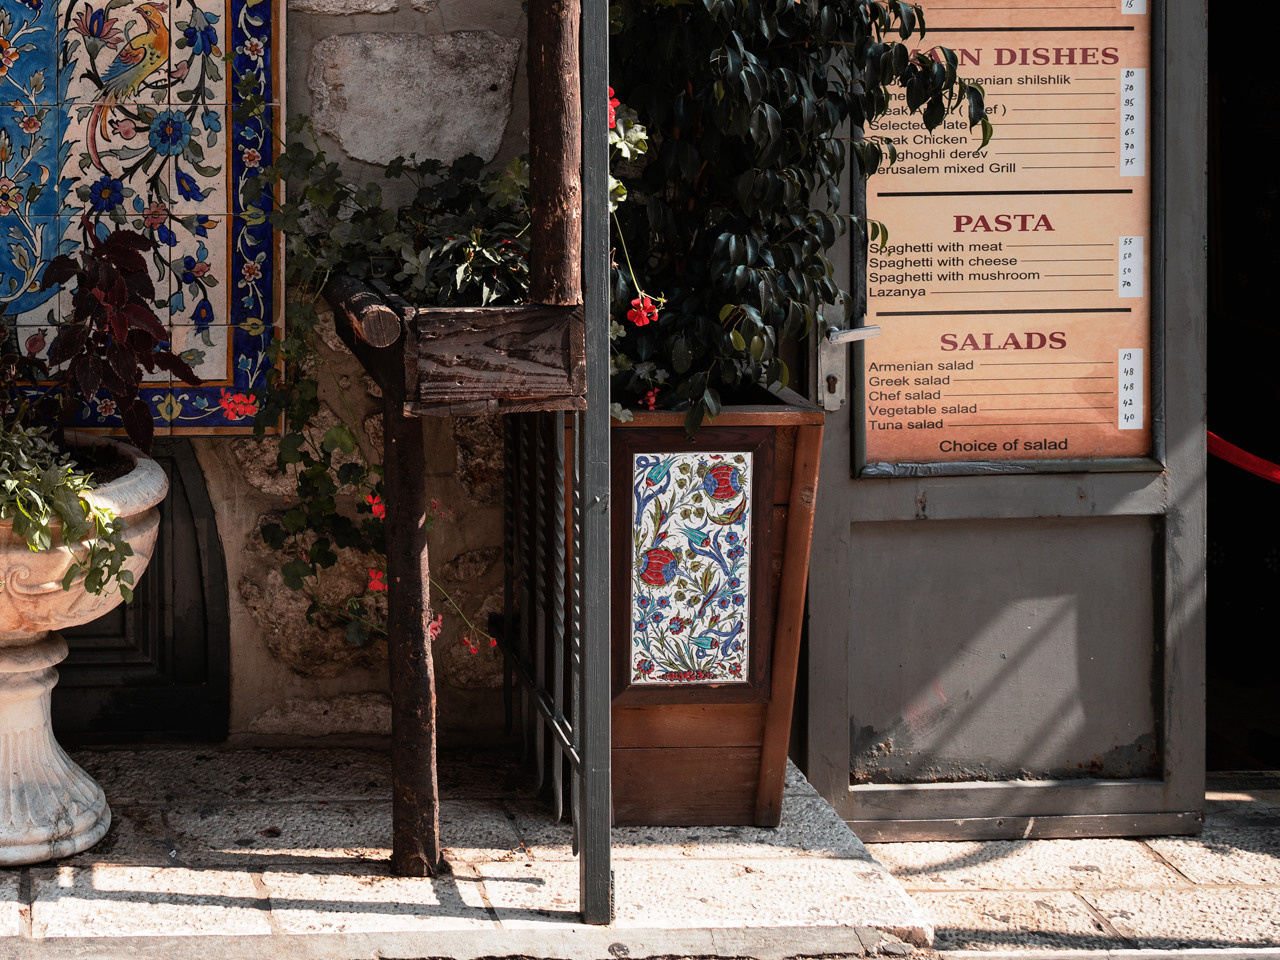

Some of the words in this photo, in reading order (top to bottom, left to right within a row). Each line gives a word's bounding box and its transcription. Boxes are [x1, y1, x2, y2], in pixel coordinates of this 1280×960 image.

[993, 46, 1120, 66] DISHES
[952, 75, 1013, 86] menian
[1017, 74, 1071, 85] shilshlik
[1125, 70, 1135, 79] 80
[1124, 84, 1134, 92] 70
[1123, 97, 1135, 107] 95
[878, 105, 909, 116] eak
[1124, 113, 1135, 122] 70
[937, 118, 968, 130] late
[1124, 128, 1135, 136] 65
[870, 135, 909, 145] Stak
[913, 134, 968, 145] Chicken
[1124, 142, 1135, 151] 70
[949, 148, 989, 159] derev
[1124, 157, 1136, 166] 75
[876, 164, 940, 175] erusalem
[944, 163, 985, 174] mixed
[988, 162, 1016, 174] Grill
[952, 213, 1056, 233] PASTA
[1123, 237, 1133, 246] 55
[869, 242, 933, 256] Spaghetti
[937, 241, 964, 253] with
[968, 241, 1003, 252] meat
[869, 256, 933, 270] Spaghetti
[936, 256, 964, 267] with
[968, 256, 1018, 267] cheese
[1122, 267, 1132, 276] 50
[869, 271, 933, 285] Spaghetti
[936, 271, 964, 282] with
[968, 270, 1040, 281] mushroom
[1122, 280, 1132, 288] 70
[869, 287, 926, 299] Lazanya
[940, 331, 1067, 352] SALADS
[1122, 352, 1132, 361] 19
[868, 361, 933, 372] Armenian
[937, 359, 974, 371] salad
[1123, 367, 1135, 376] 48
[868, 375, 910, 387] Greek
[913, 374, 950, 386] salad
[1123, 382, 1135, 392] 48
[868, 390, 902, 402] Chef
[904, 389, 941, 401] salad
[1122, 398, 1133, 407] 42
[868, 404, 937, 418] Vegetable
[941, 403, 977, 415] salad
[1123, 413, 1135, 423] 40
[868, 420, 903, 431] Tuna
[907, 418, 944, 430] salad
[939, 439, 998, 453] Choice
[1002, 438, 1020, 452] of
[1023, 437, 1068, 451] salad
